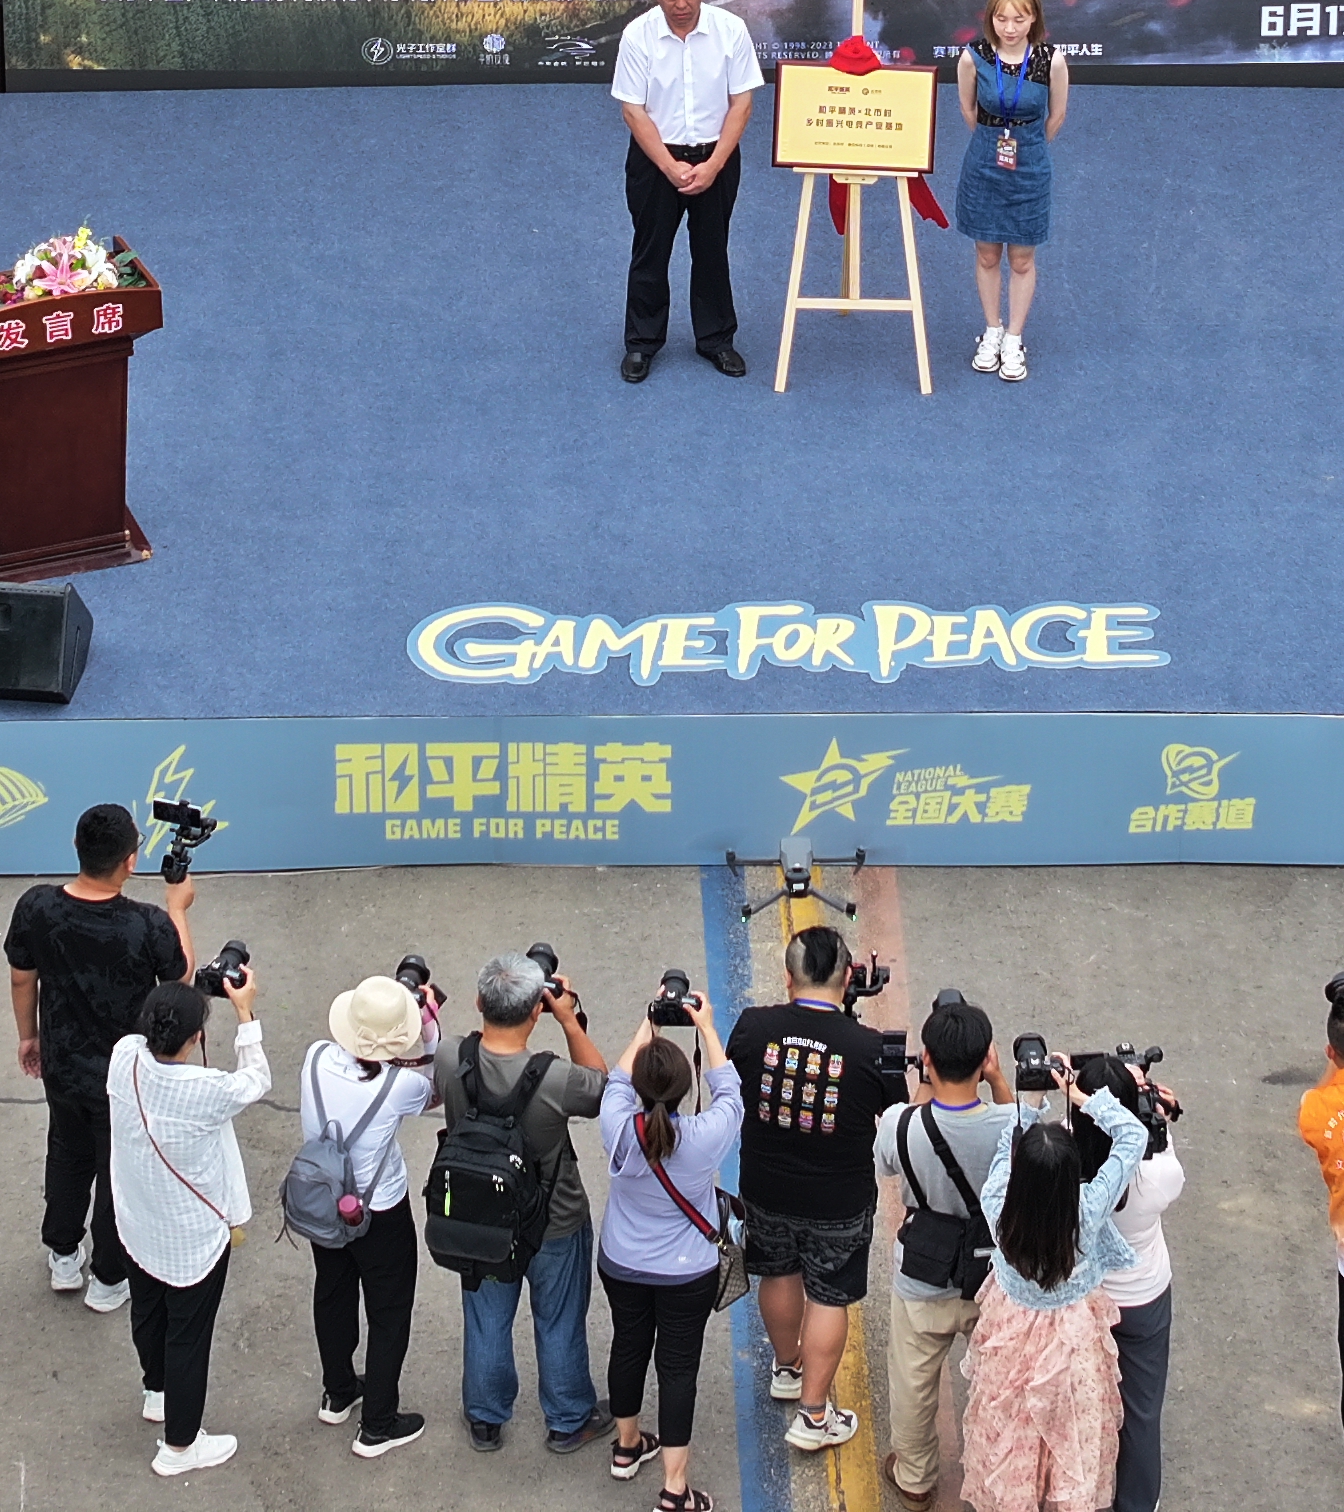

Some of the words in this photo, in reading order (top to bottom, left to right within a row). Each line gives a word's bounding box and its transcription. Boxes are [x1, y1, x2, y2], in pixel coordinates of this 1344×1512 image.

[872, 603, 1155, 679] PEACE
[334, 741, 672, 814] 和平精英
[892, 777, 947, 794] LEAGUE
[893, 763, 965, 783] NATIONAL
[885, 784, 1032, 826] 全国大赛
[1128, 796, 1256, 834] 合作赛道
[385, 817, 462, 840] GAME
[473, 817, 524, 839] FOR
[536, 818, 619, 840] PEACE
